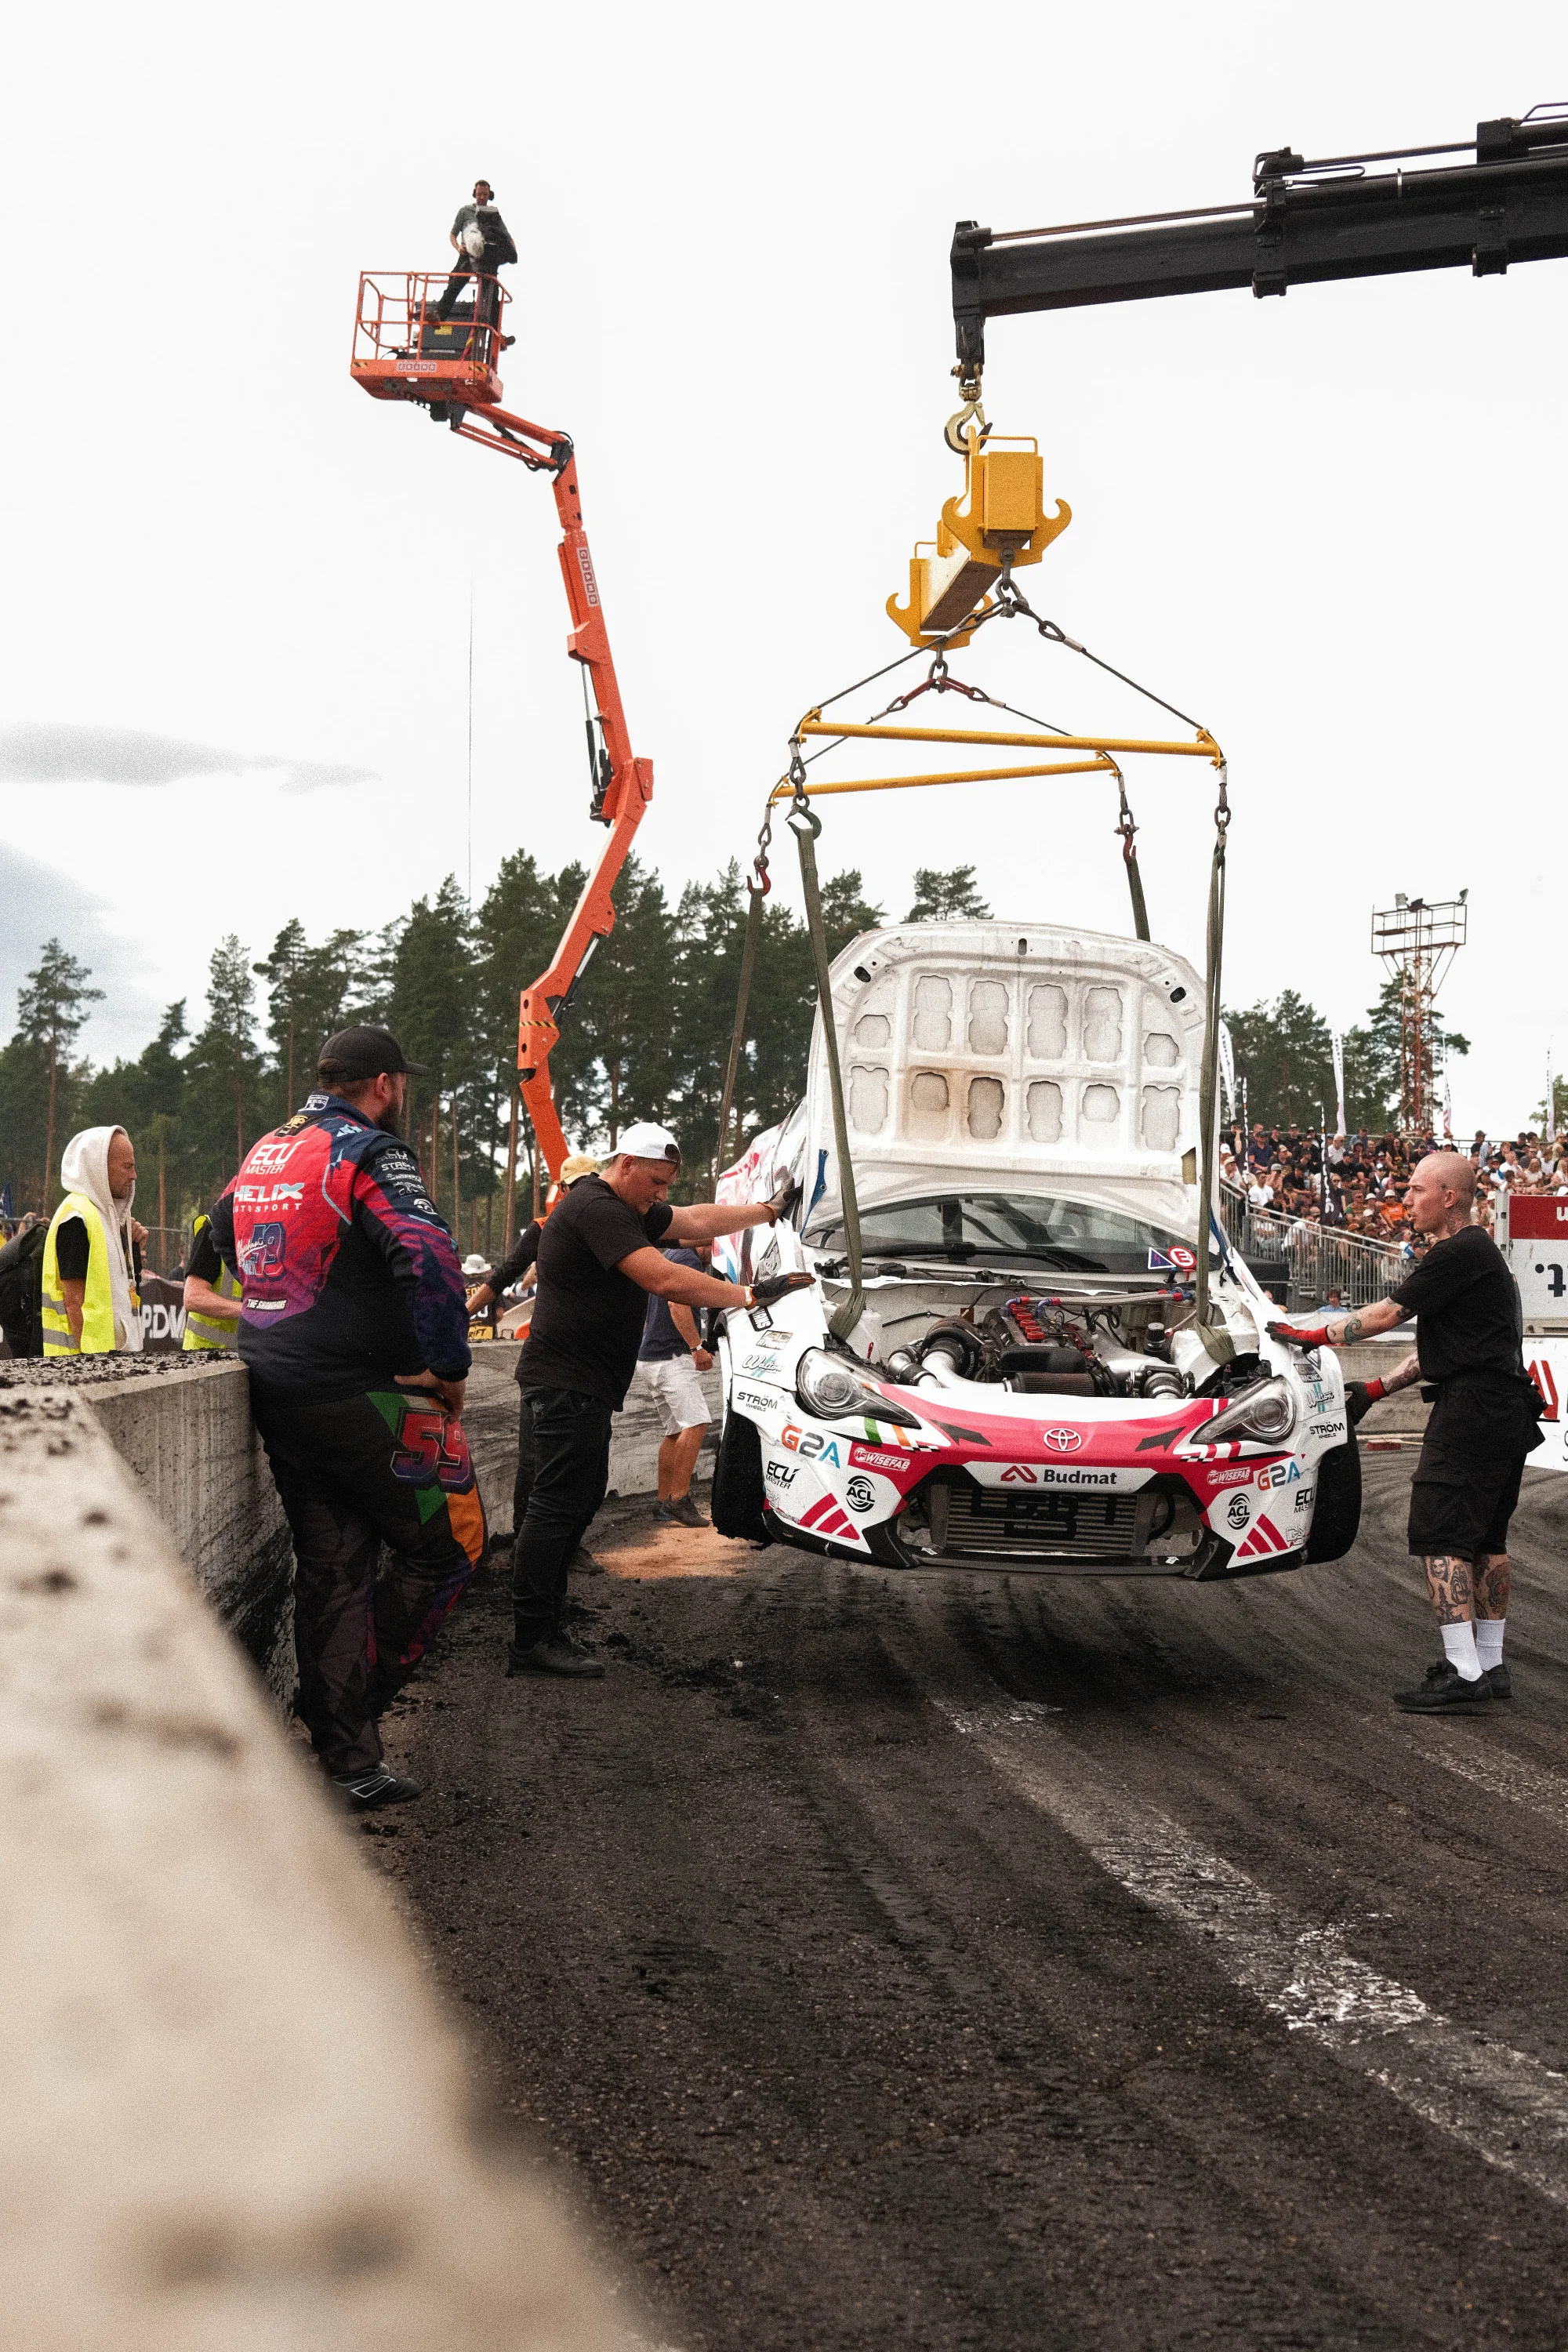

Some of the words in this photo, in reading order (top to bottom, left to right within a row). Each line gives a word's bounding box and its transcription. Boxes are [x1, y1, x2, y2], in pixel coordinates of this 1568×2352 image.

[251, 1140, 307, 1166] ECU
[245, 1164, 285, 1174] MASTER
[234, 1183, 305, 1202] HELIX
[234, 1203, 302, 1213] UTOSPORT
[742, 1355, 783, 1372] Walton
[737, 1392, 779, 1410] STRÖM
[1309, 1421, 1345, 1435] STRÖM
[390, 1408, 470, 1487] 59
[781, 1424, 840, 1469] G2A
[866, 1452, 911, 1471] WISEFAB
[767, 1461, 801, 1483] ECU
[1043, 1468, 1117, 1485] Budmat
[1218, 1468, 1250, 1483] WISEFAB
[1257, 1461, 1301, 1491] G2A
[766, 1474, 791, 1490] MASTER
[847, 1486, 876, 1503] ACL
[1227, 1505, 1250, 1519] ACL
